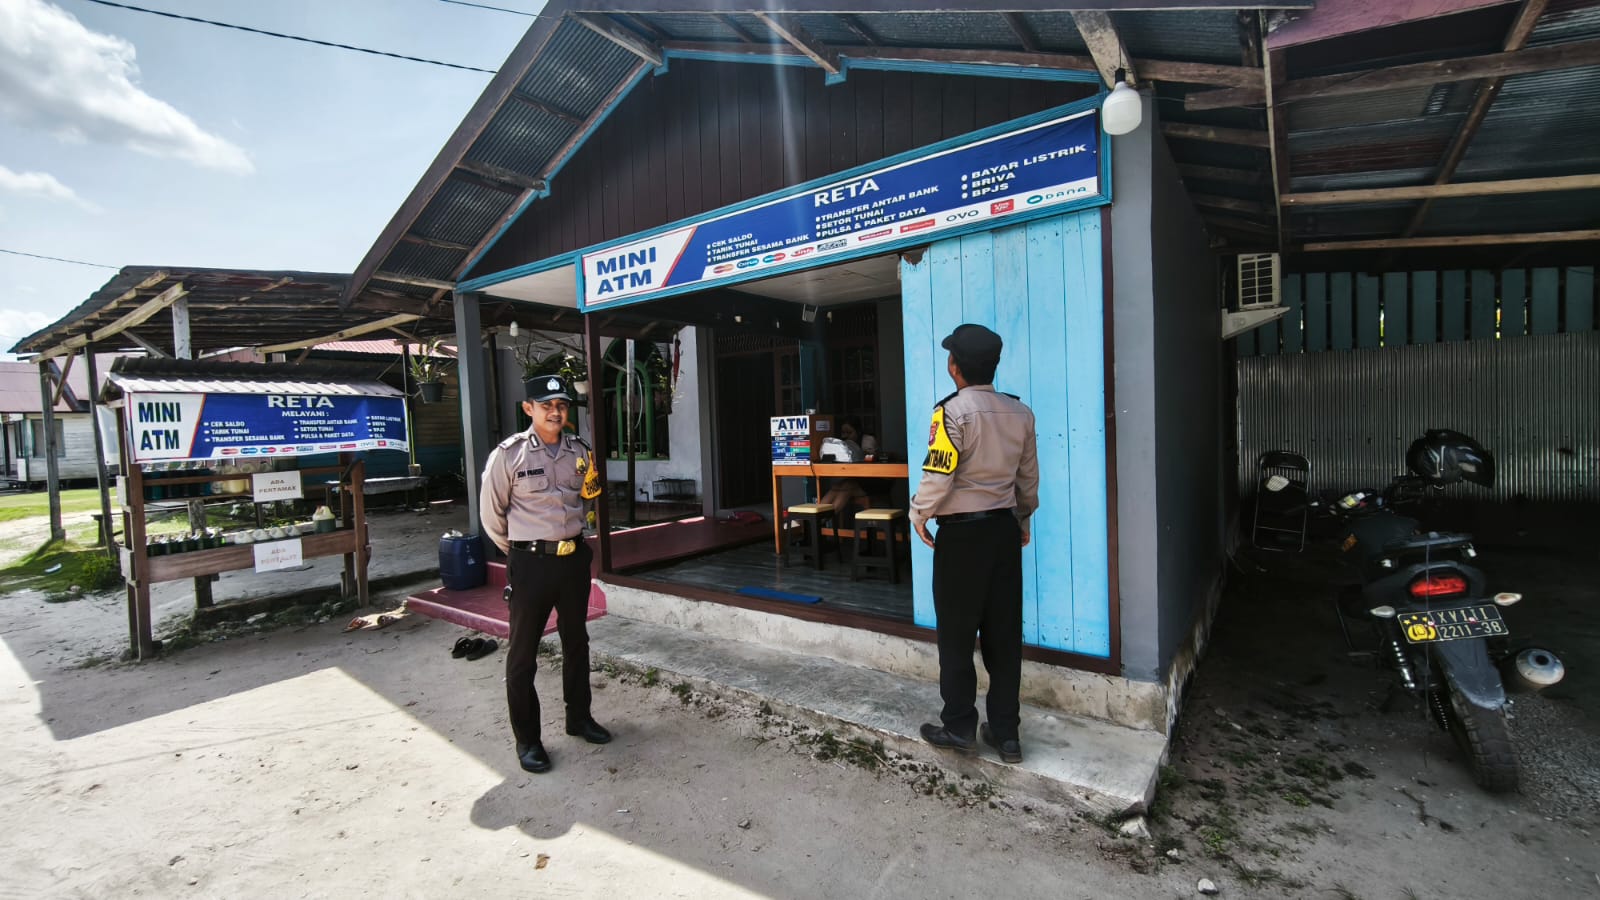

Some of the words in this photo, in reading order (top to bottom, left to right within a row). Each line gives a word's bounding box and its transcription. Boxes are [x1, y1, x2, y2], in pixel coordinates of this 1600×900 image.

[972, 161, 1019, 179] BAYAR
[1023, 144, 1086, 166] LISTRIK
[972, 172, 1015, 188] BRIVA
[972, 182, 1009, 198] BPJS
[815, 178, 880, 207] RETA
[822, 204, 869, 221] TRANSFER
[872, 194, 905, 209] ANTAR
[909, 185, 939, 199] BANK
[822, 214, 851, 229] SETOR
[854, 208, 884, 222] TUNAI
[822, 225, 851, 238] PULSA
[864, 215, 896, 227] PAKET
[899, 206, 926, 219] DATA
[946, 209, 979, 221] OVO
[712, 240, 726, 248] CEK
[728, 233, 752, 243] SALDO
[712, 244, 733, 254] TARIK
[735, 239, 758, 249] TUNAI
[712, 249, 750, 262] TRANSFER
[752, 240, 784, 252] SESAMA
[785, 234, 809, 245] BANK
[596, 247, 657, 276] MINI
[597, 269, 652, 295] ATM
[267, 395, 334, 408] RETA
[138, 402, 181, 423] MINI
[778, 417, 807, 430] ATM
[140, 429, 180, 450] ATM
